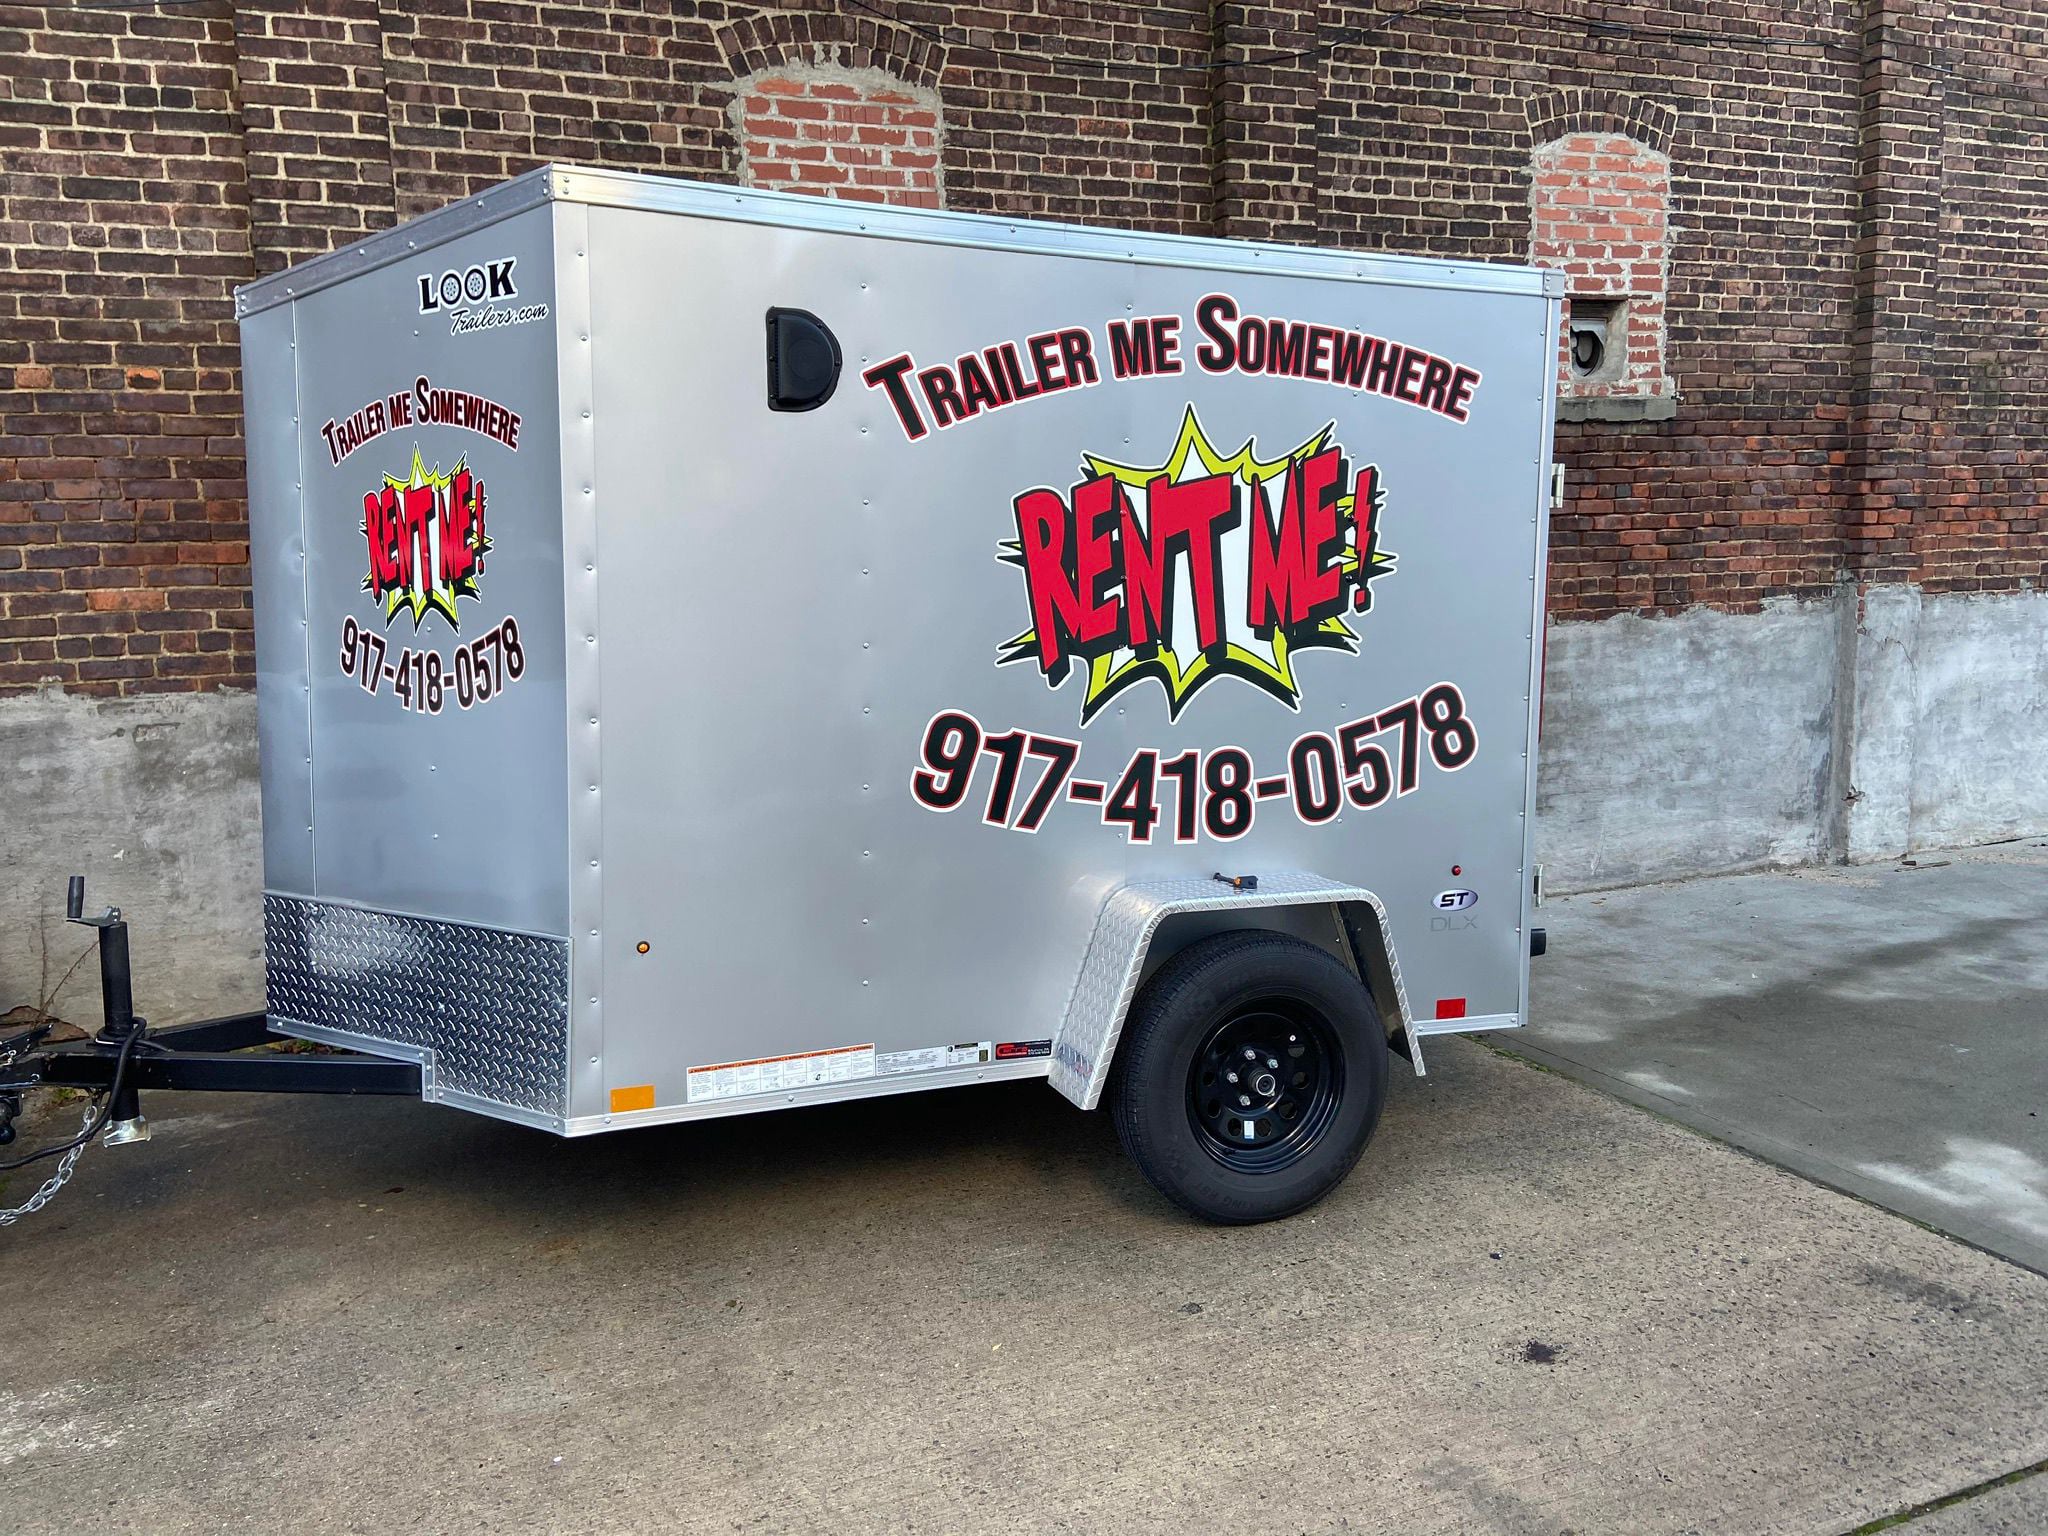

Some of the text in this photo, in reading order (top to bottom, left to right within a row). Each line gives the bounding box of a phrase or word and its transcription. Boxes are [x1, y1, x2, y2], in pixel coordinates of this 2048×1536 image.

[418, 258, 518, 312] LOOK
[450, 303, 549, 335] Trailers.com
[863, 293, 1480, 441] TRAILER ME SOMEWHERE
[321, 376, 523, 466] TRAILER ME SOMEWHERE
[363, 467, 486, 603] RENT ME!
[1012, 445, 1378, 684] RENT ME!
[341, 616, 525, 714] 917-418-0578
[912, 683, 1478, 843] 917-418-0578
[1430, 914, 1479, 932] DLX
[1439, 891, 1470, 908] ST
